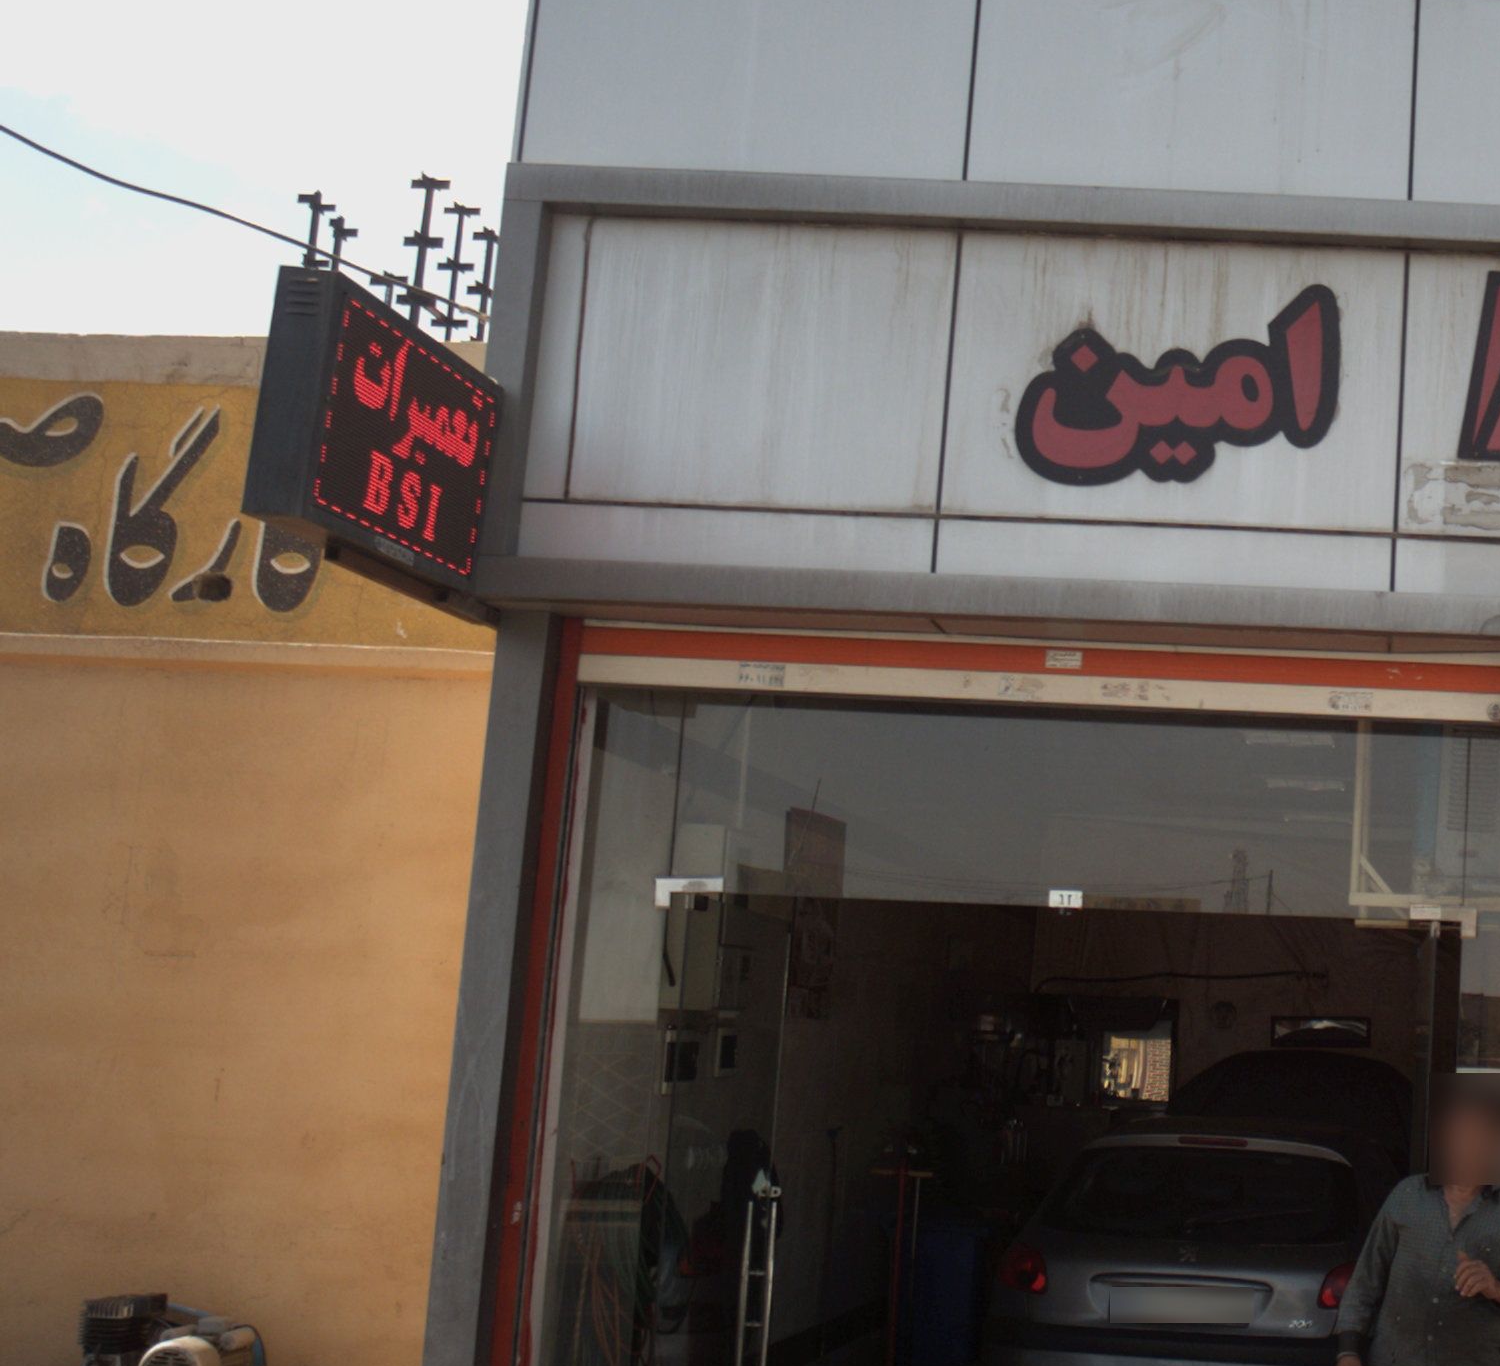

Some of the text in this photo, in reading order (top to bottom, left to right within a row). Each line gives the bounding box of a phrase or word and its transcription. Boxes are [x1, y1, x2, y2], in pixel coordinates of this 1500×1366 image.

[353, 337, 480, 468] تعمیرات
[1015, 285, 1341, 485] امین
[362, 449, 443, 542] BSI
